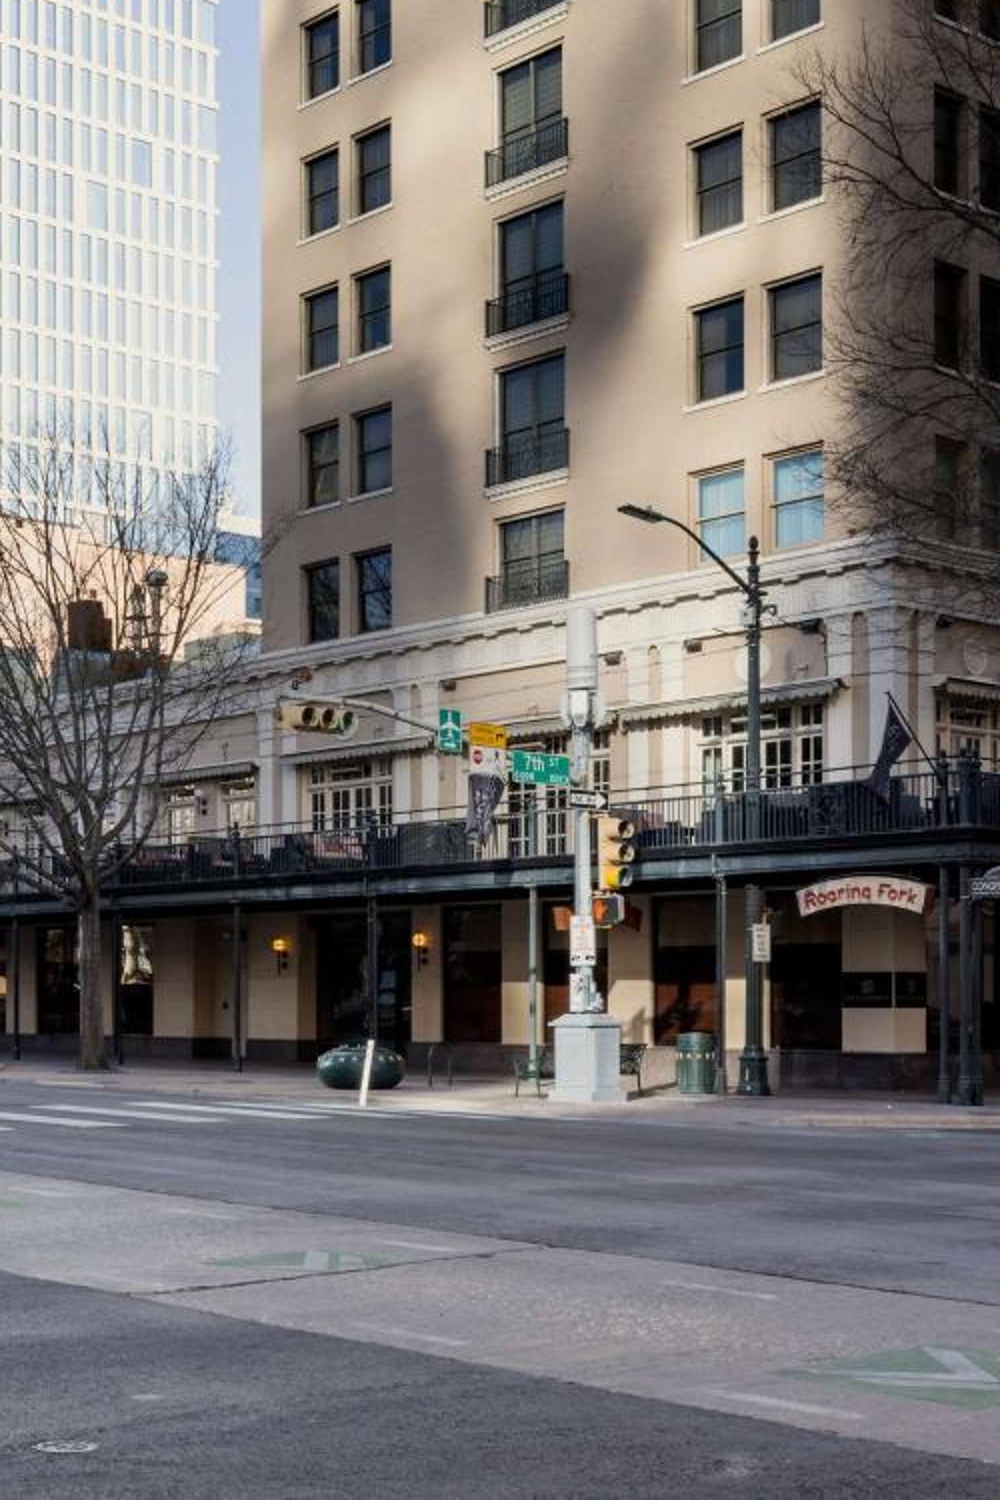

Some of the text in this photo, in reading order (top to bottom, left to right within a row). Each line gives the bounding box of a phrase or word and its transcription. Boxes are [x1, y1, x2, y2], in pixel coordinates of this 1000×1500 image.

[525, 755, 545, 772] 7th
[804, 883, 917, 909] Roaring Fork
